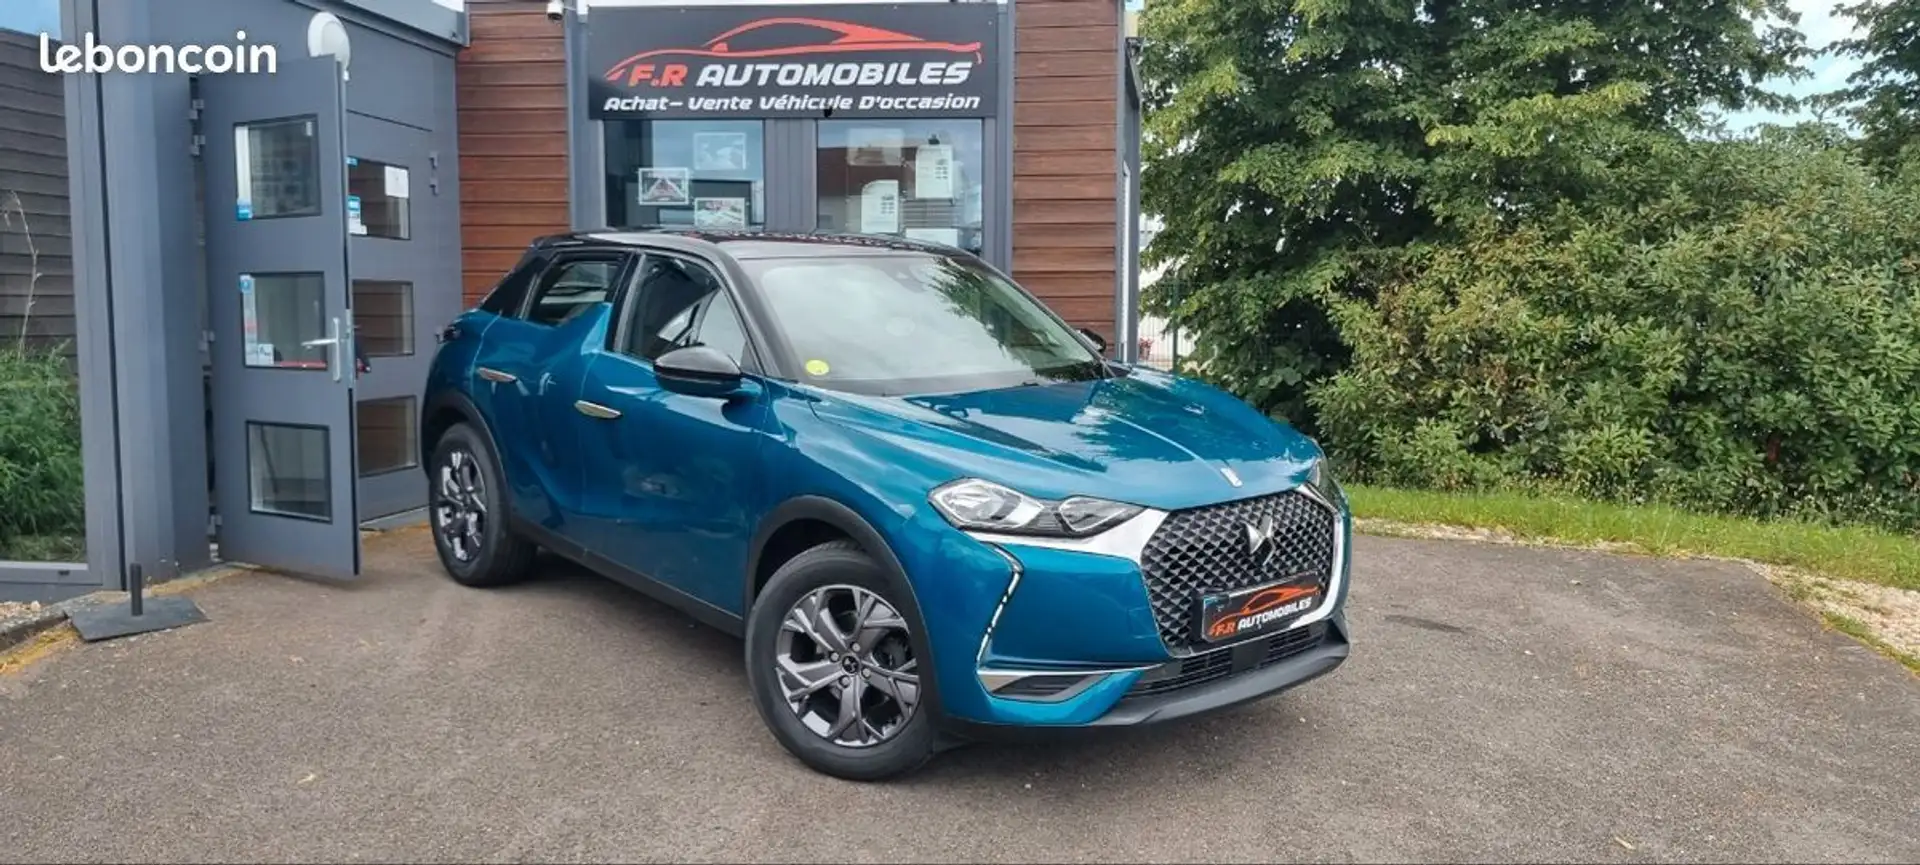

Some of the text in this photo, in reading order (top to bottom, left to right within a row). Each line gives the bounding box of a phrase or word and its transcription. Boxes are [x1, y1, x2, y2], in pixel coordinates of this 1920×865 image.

[628, 62, 972, 87] F.R AUTOMOBILES
[688, 97, 753, 111] Vente
[760, 94, 853, 110] Véhicule
[858, 93, 980, 110] D'occasion
[1237, 597, 1312, 631] AUTOMOBILES
